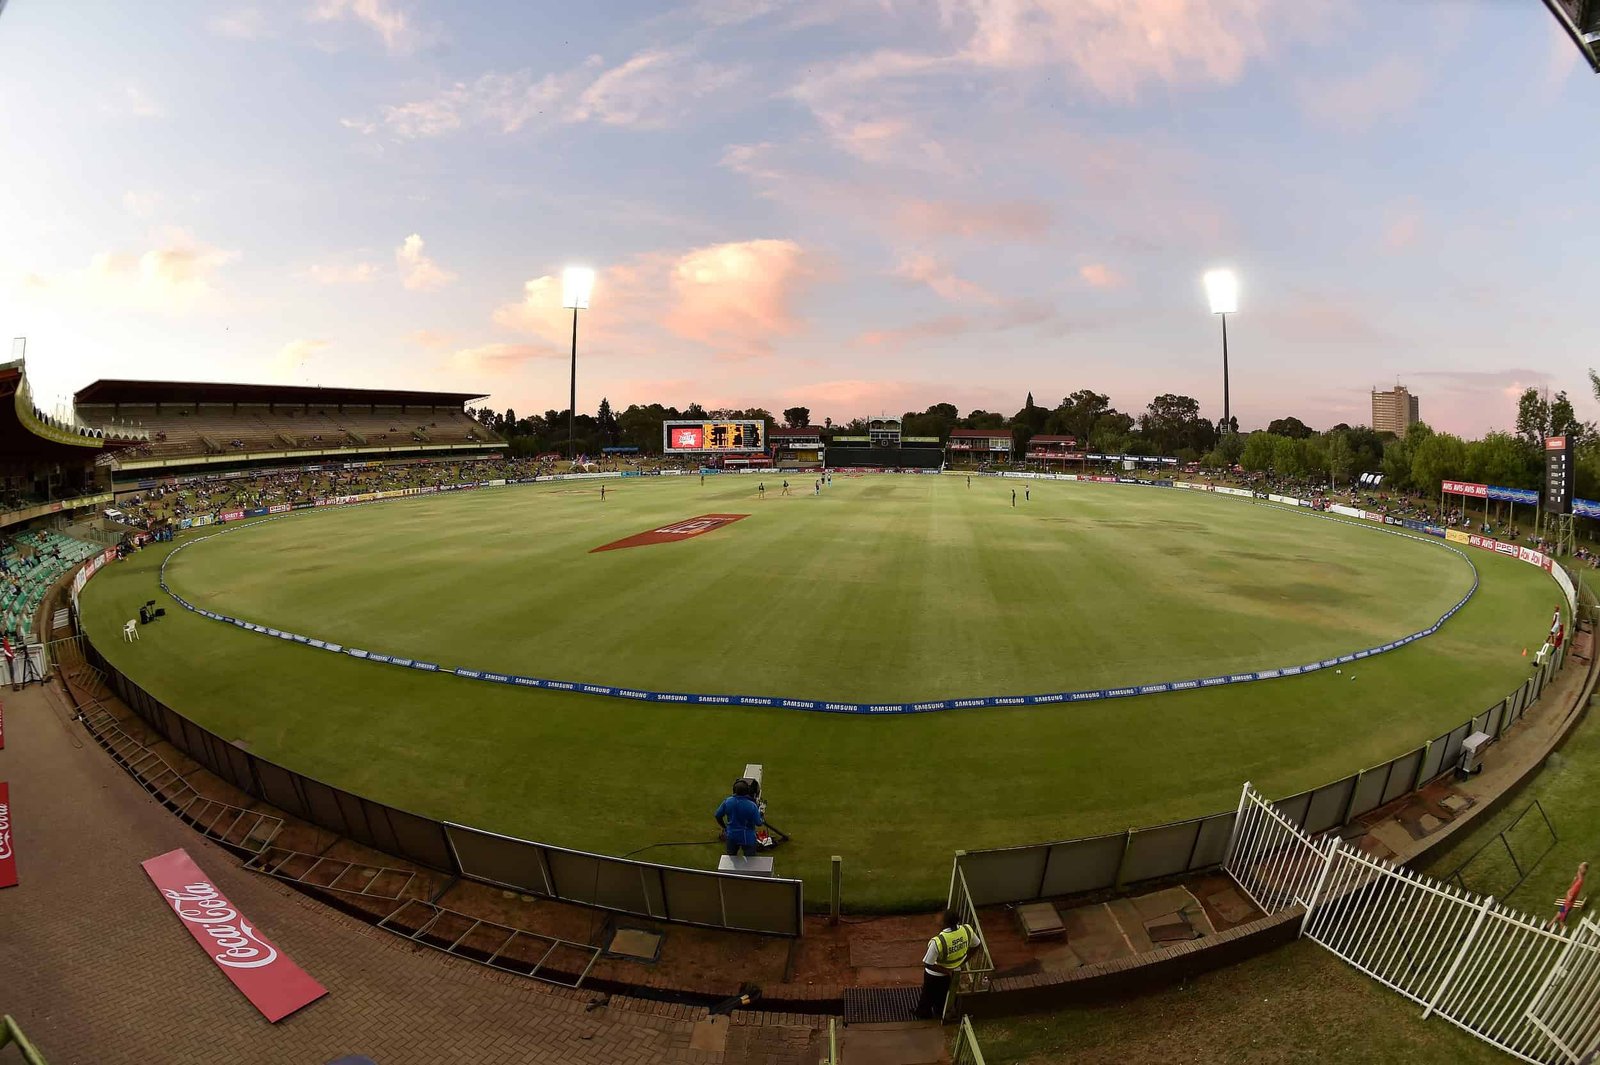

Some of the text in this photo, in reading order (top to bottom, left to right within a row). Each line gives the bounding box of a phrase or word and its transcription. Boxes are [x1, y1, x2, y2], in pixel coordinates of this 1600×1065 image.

[1443, 483, 1487, 495] AVIS AVIS AVIS AVIS
[1470, 537, 1481, 546] AVIS
[1482, 540, 1493, 549] AVIS
[515, 678, 540, 686] SAMSUNG
[547, 681, 574, 689] SAMSUNG
[583, 685, 611, 694] SAMSUNG
[619, 689, 647, 698] SAMSUNG
[740, 697, 772, 705] SAMSUNG
[782, 700, 814, 708] SAMSUNG
[825, 703, 858, 711] SAMSUNG
[913, 702, 944, 711] SAMSUNG
[954, 699, 985, 707] SAMSUNG
[1034, 694, 1063, 702] SAMSUNG
[1108, 688, 1134, 696] SAMSUNG
[1142, 684, 1167, 692] SAMSUNG
[1203, 677, 1225, 685] SAMSUNG
[161, 881, 277, 968] Coca-Cola
[949, 940, 968, 954] SECURITY
